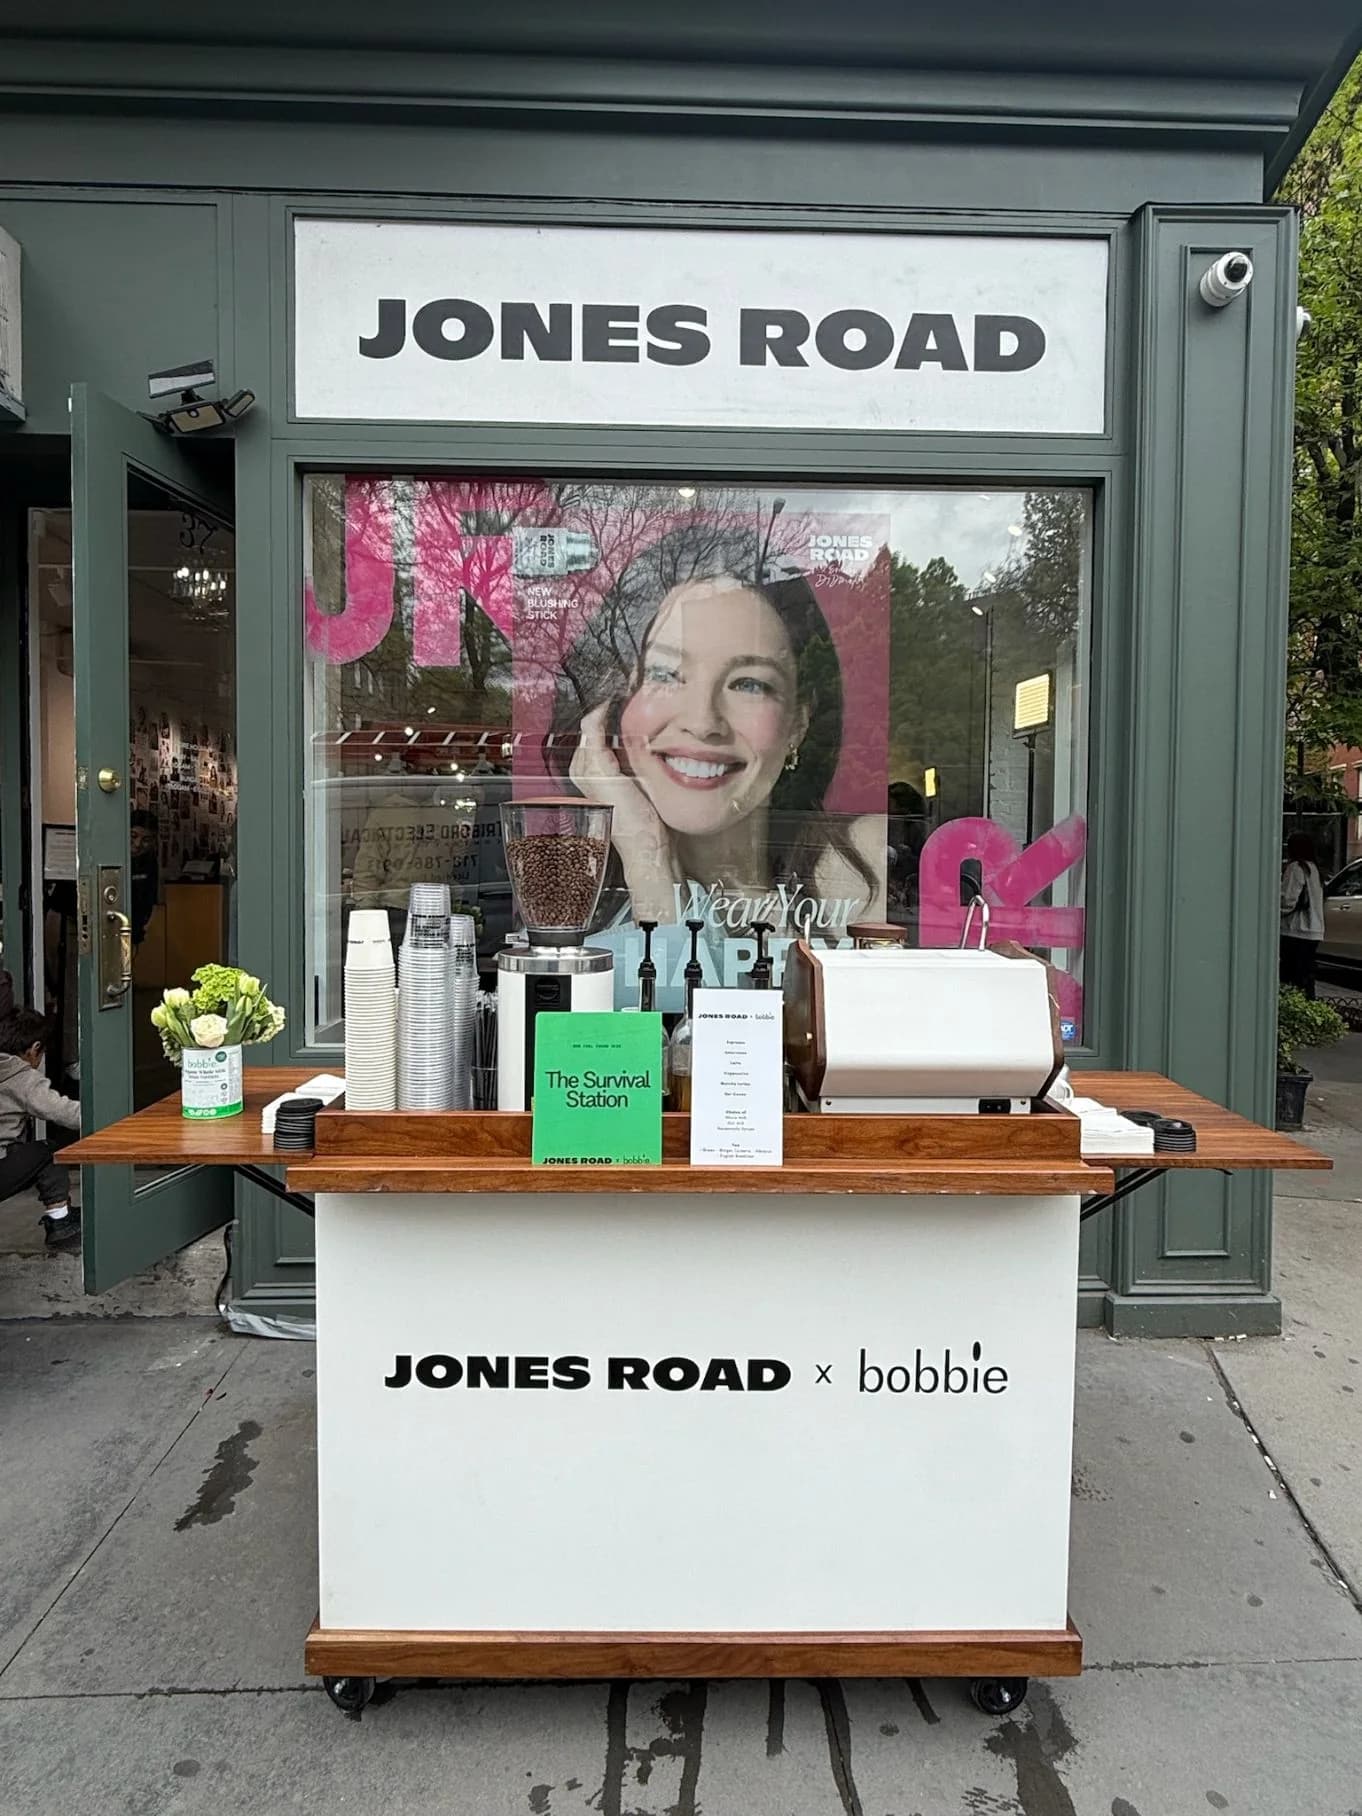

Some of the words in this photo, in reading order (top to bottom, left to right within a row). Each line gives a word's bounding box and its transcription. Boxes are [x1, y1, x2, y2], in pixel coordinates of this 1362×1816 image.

[358, 297, 711, 366] JONES
[739, 308, 1047, 372] ROAD
[807, 535, 873, 548] JONES
[810, 548, 869, 561] ROAD
[527, 587, 552, 596] NEW
[527, 600, 578, 608] BLUSHING
[526, 611, 557, 620] STICK
[673, 880, 774, 929] Wear
[776, 883, 861, 930] Your
[545, 1071, 579, 1089] The
[583, 1069, 651, 1089] Survival
[565, 1090, 629, 1108] Station
[543, 1157, 578, 1165] JONES
[580, 1157, 613, 1165] ROAD
[623, 1154, 650, 1165] bobbie
[384, 1354, 592, 1390] JONES
[607, 1356, 792, 1391] ROAD
[815, 1363, 833, 1384] x
[858, 1341, 1009, 1394] bobbie
